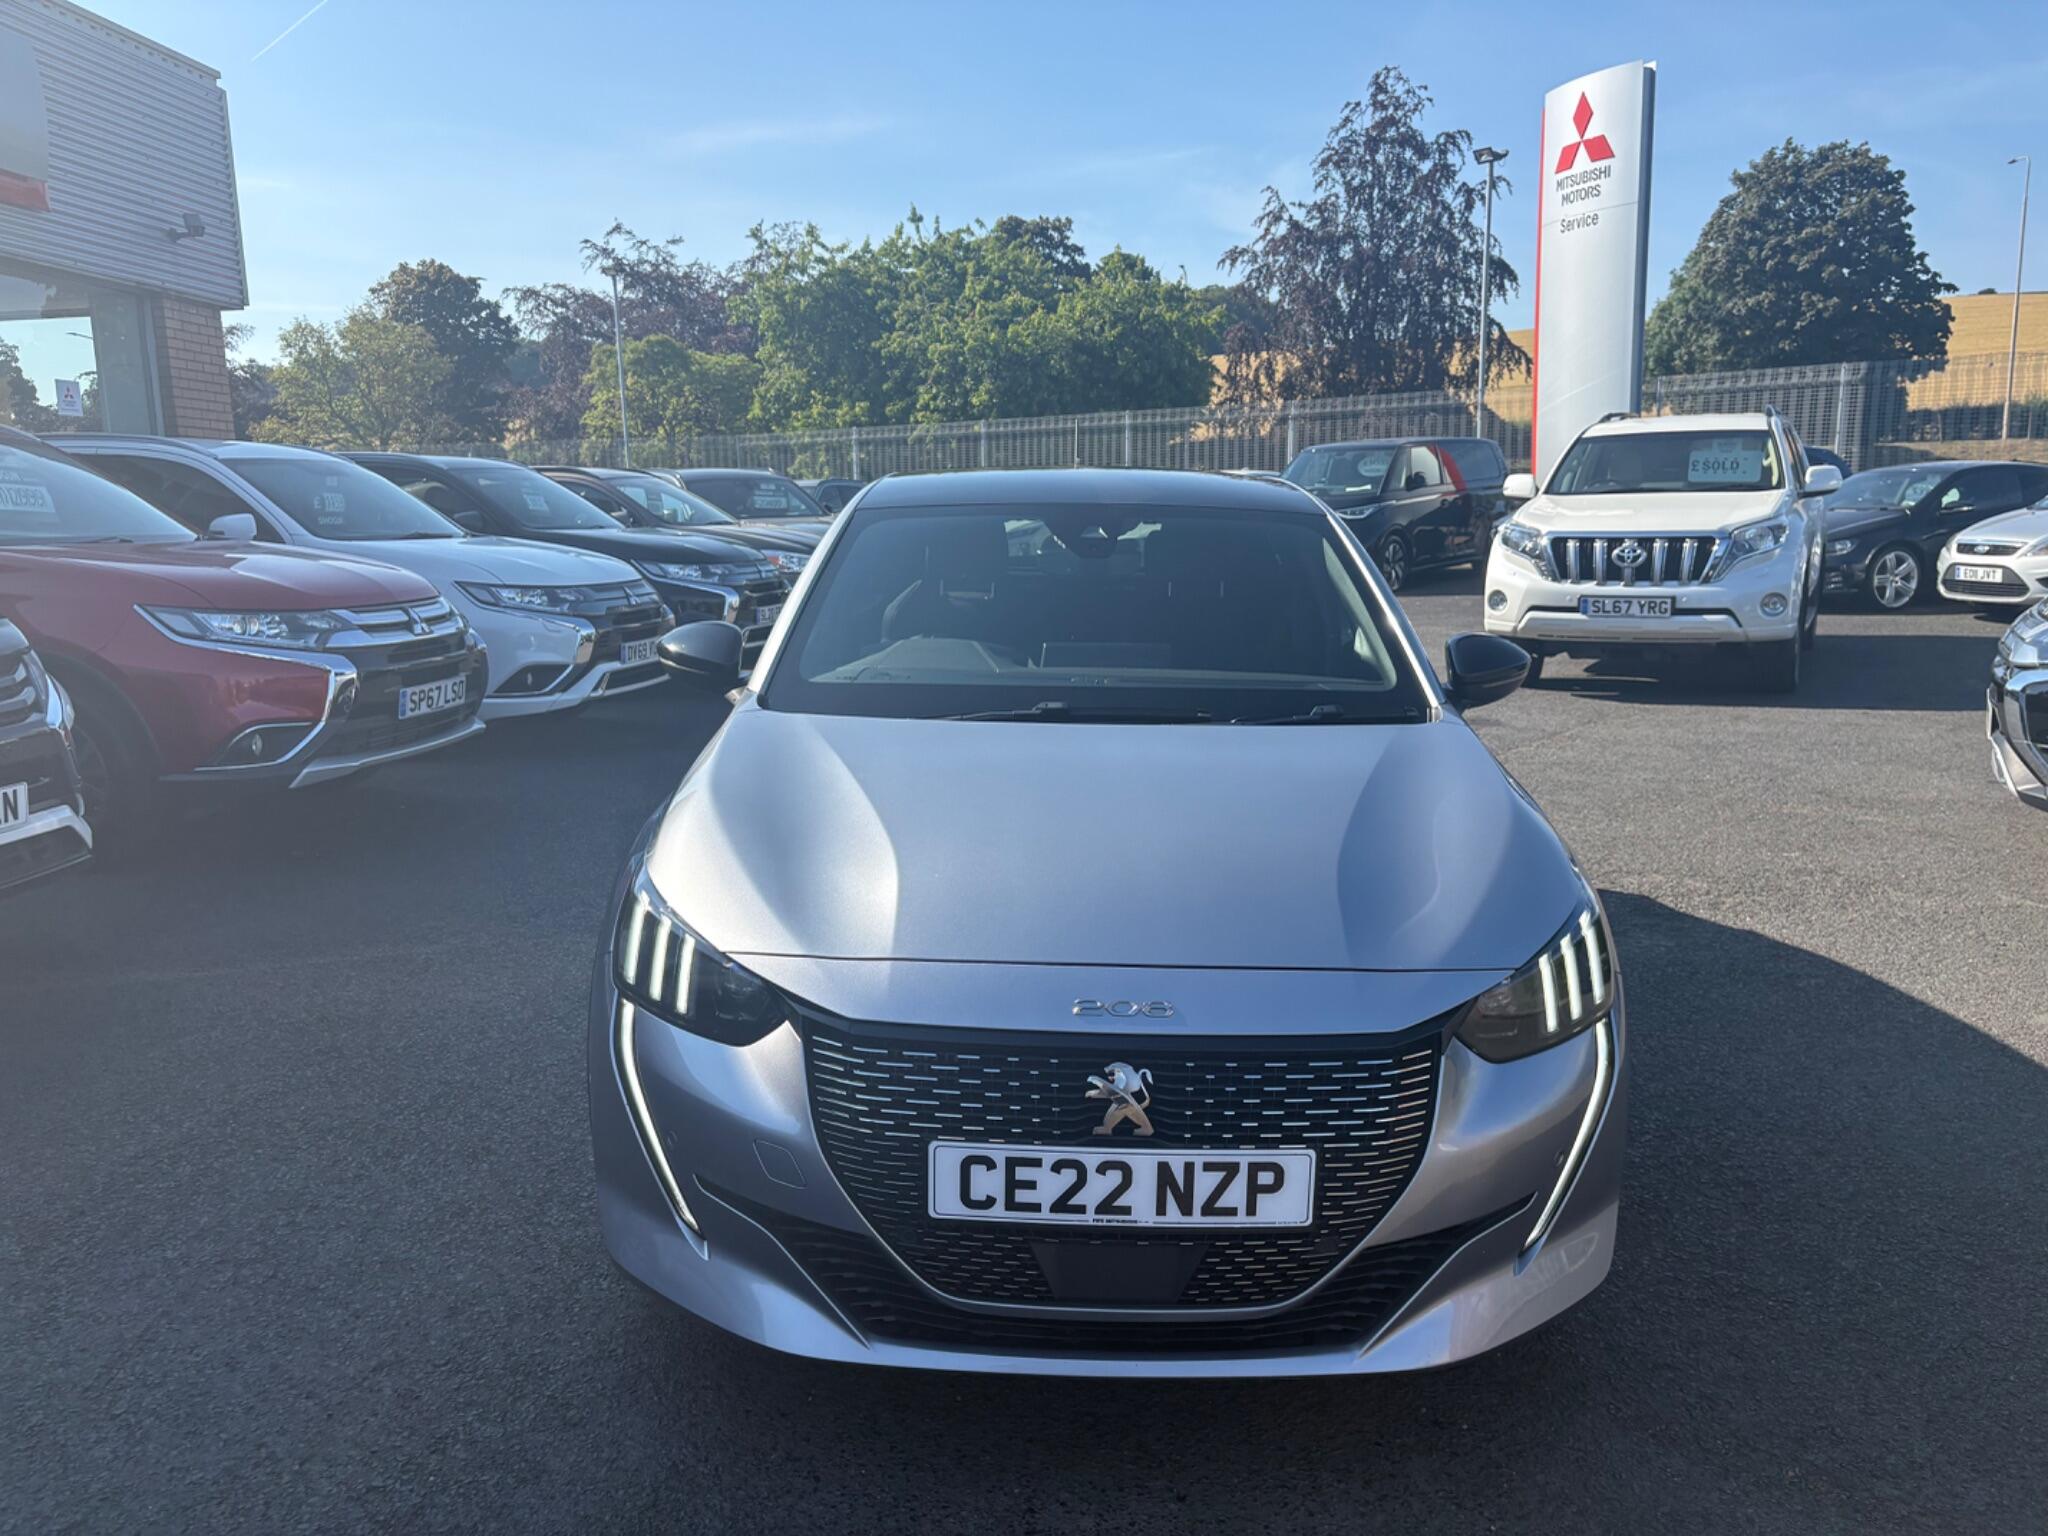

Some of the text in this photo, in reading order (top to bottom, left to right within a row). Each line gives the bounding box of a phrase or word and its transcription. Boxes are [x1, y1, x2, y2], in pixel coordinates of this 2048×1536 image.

[1556, 165, 1611, 192] MITSUBISHI
[1561, 184, 1601, 206] MOTORS
[1560, 213, 1599, 233] Service
[1980, 569, 1996, 580] JVT
[1592, 600, 1668, 614] SL67 YRG
[409, 686, 442, 712] SP67
[1072, 999, 1175, 1018] 208
[959, 1155, 1285, 1217] CE22 NZP
